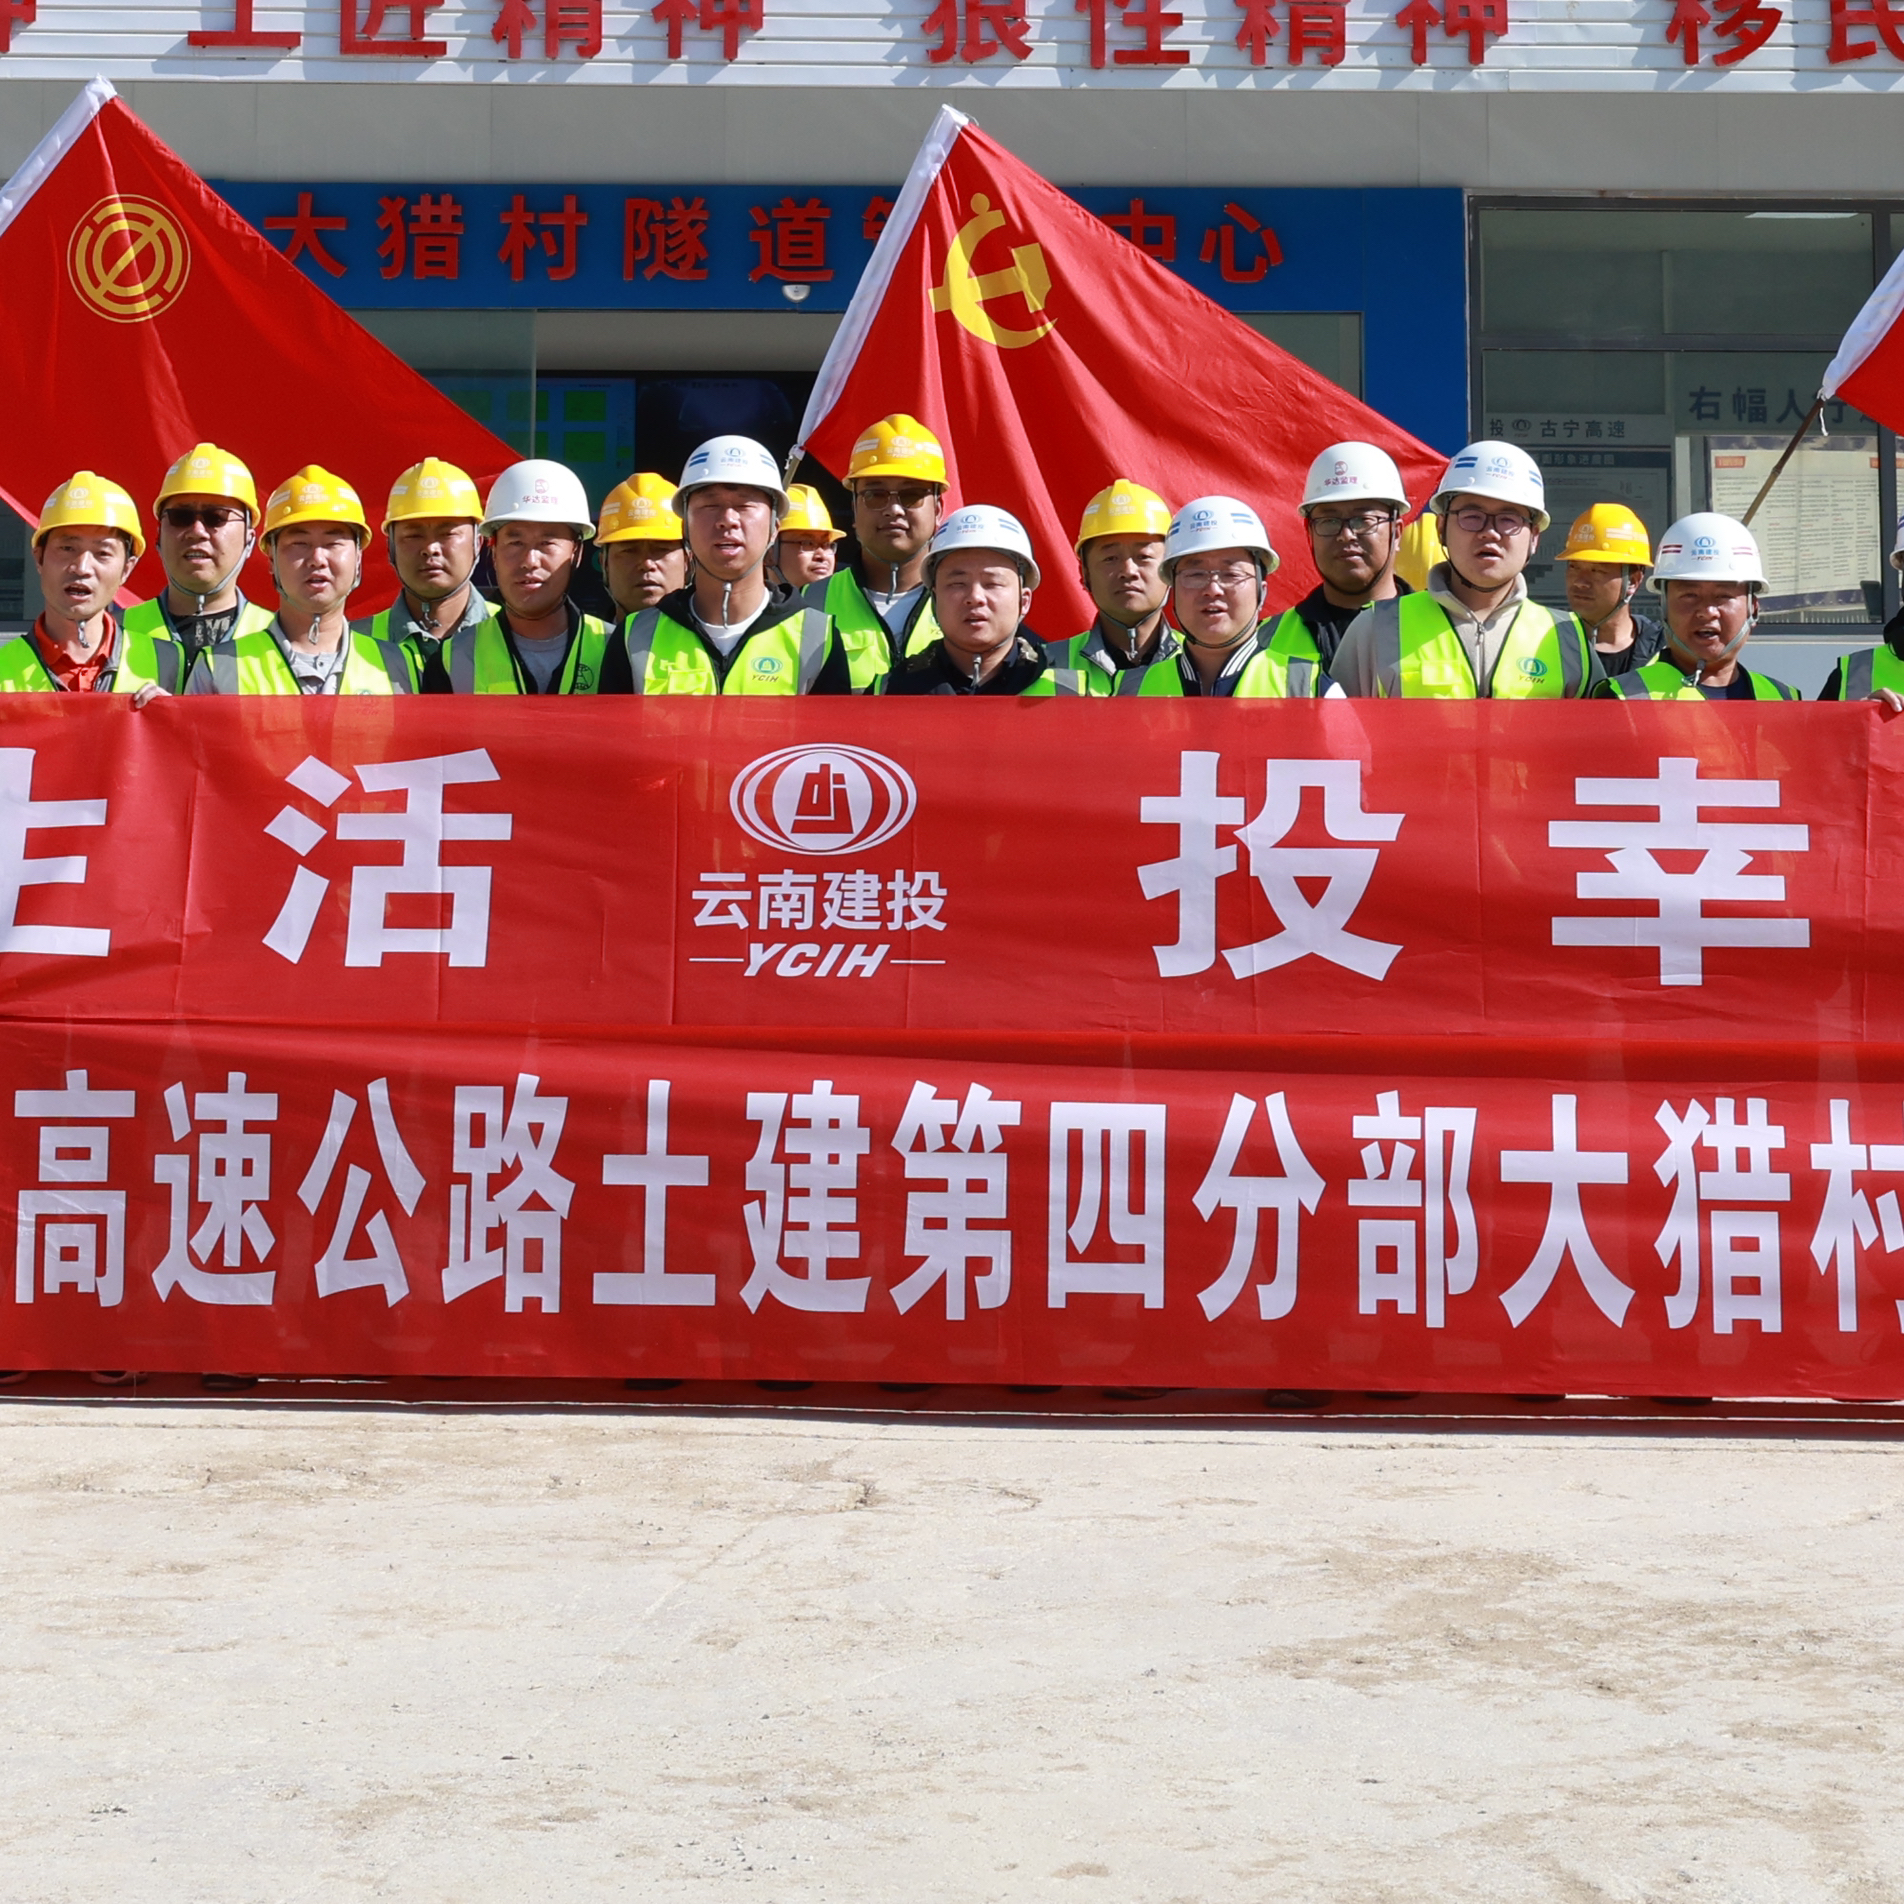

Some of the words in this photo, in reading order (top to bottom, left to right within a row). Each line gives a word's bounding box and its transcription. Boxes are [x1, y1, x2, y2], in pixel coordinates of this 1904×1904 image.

[1541, 420, 1626, 439] 古宁高速
[1486, 466, 1514, 476] 云南建投
[1324, 476, 1358, 486] 华达监理
[522, 496, 558, 504] 华达监理
[1190, 521, 1217, 529] 云南建投
[752, 674, 779, 682] YCIH
[1519, 676, 1544, 684] YCIH
[692, 869, 947, 931] 云南建投
[744, 943, 890, 977] YCIH
